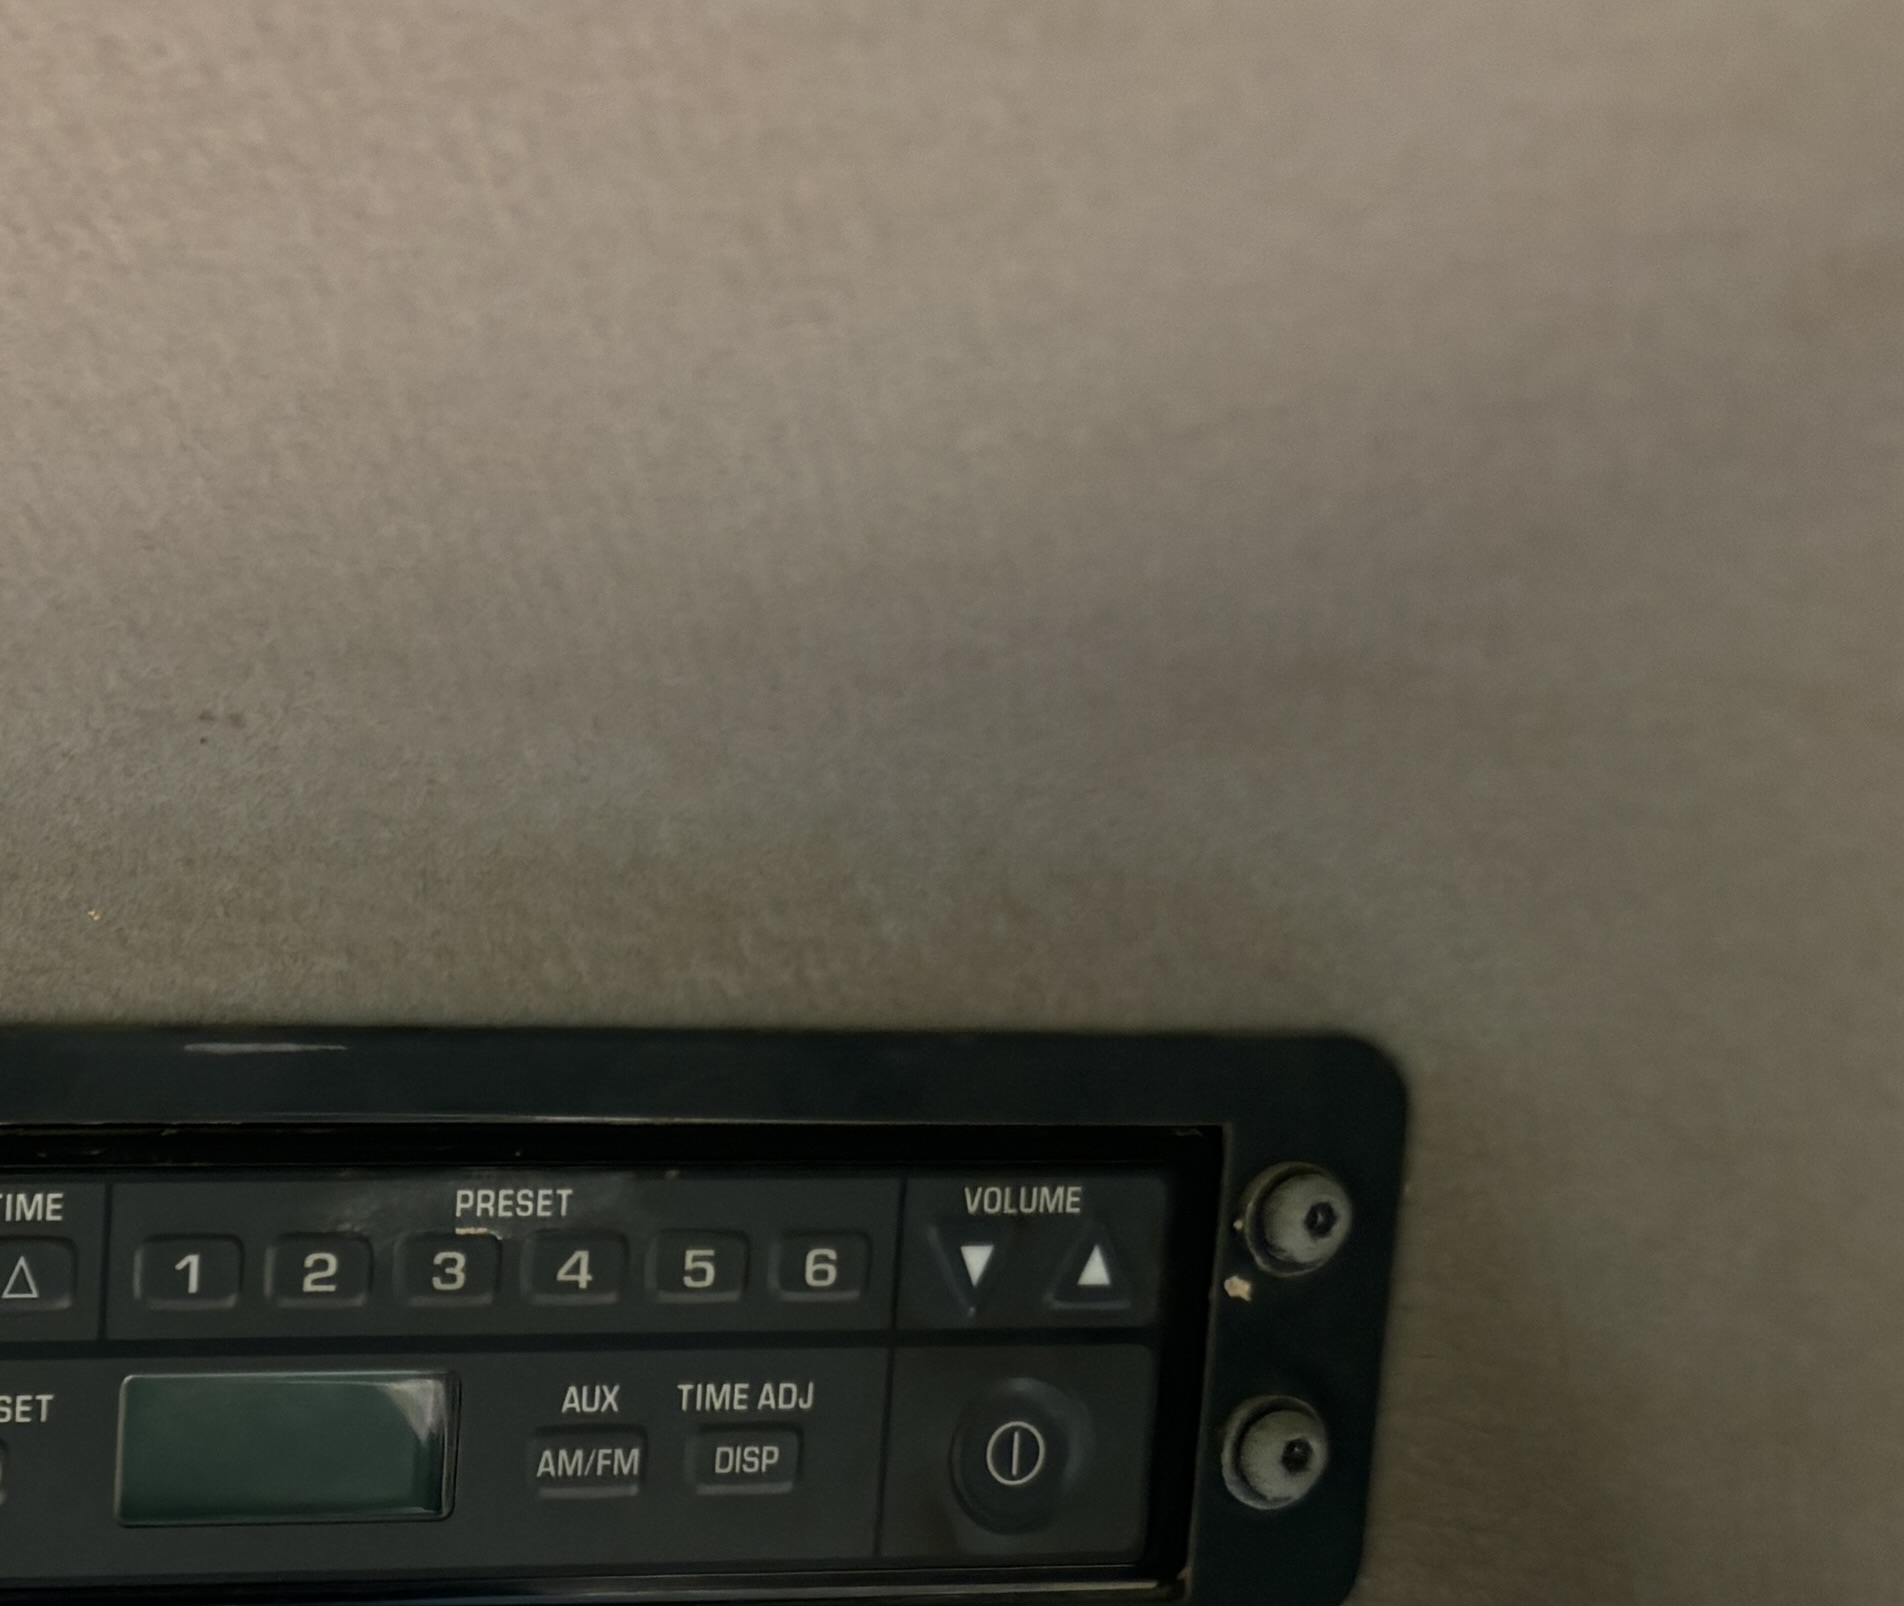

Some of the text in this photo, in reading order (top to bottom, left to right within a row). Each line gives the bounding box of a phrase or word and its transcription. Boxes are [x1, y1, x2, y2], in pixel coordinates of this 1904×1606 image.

[455, 1188, 574, 1218] PRESET
[963, 1185, 1081, 1215] VOLUME
[174, 1254, 200, 1294] 1
[302, 1253, 338, 1293] 2
[431, 1251, 467, 1291] 3
[555, 1250, 594, 1290] 4
[683, 1249, 716, 1288] 5
[804, 1248, 838, 1287] 6
[561, 1385, 621, 1414] AUX
[677, 1381, 816, 1412] TIME ADJ
[535, 1448, 640, 1480] AM/FM
[714, 1445, 780, 1475] DISP
